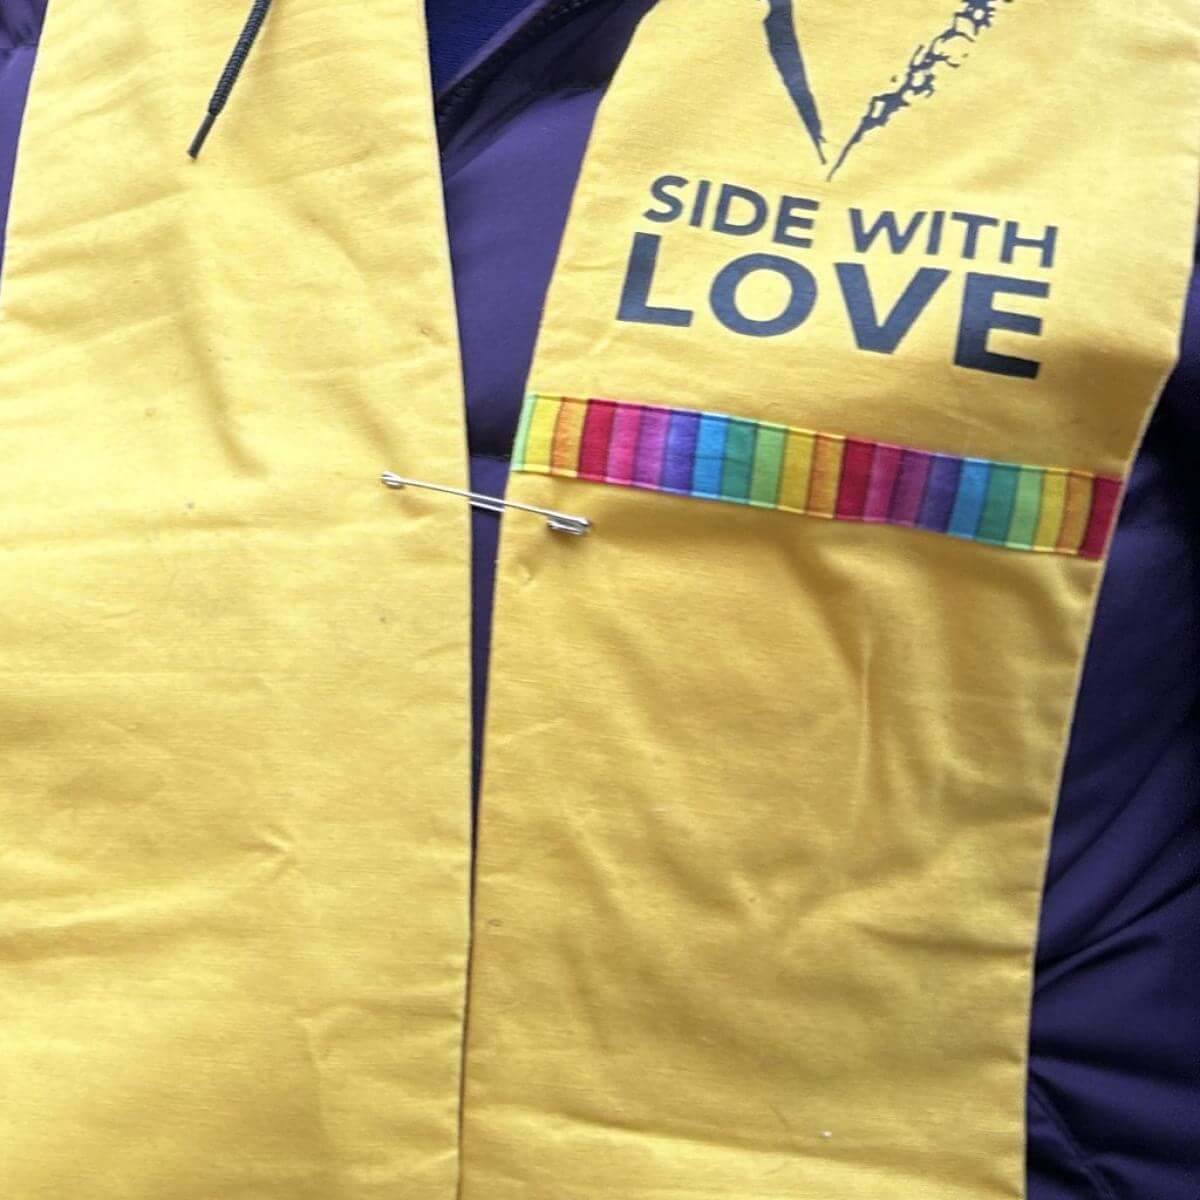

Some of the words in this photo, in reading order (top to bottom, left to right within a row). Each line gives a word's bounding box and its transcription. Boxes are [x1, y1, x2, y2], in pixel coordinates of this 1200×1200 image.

[642, 175, 820, 249] SIDE
[848, 207, 1058, 268] WITH
[616, 231, 1050, 380] LOVE
